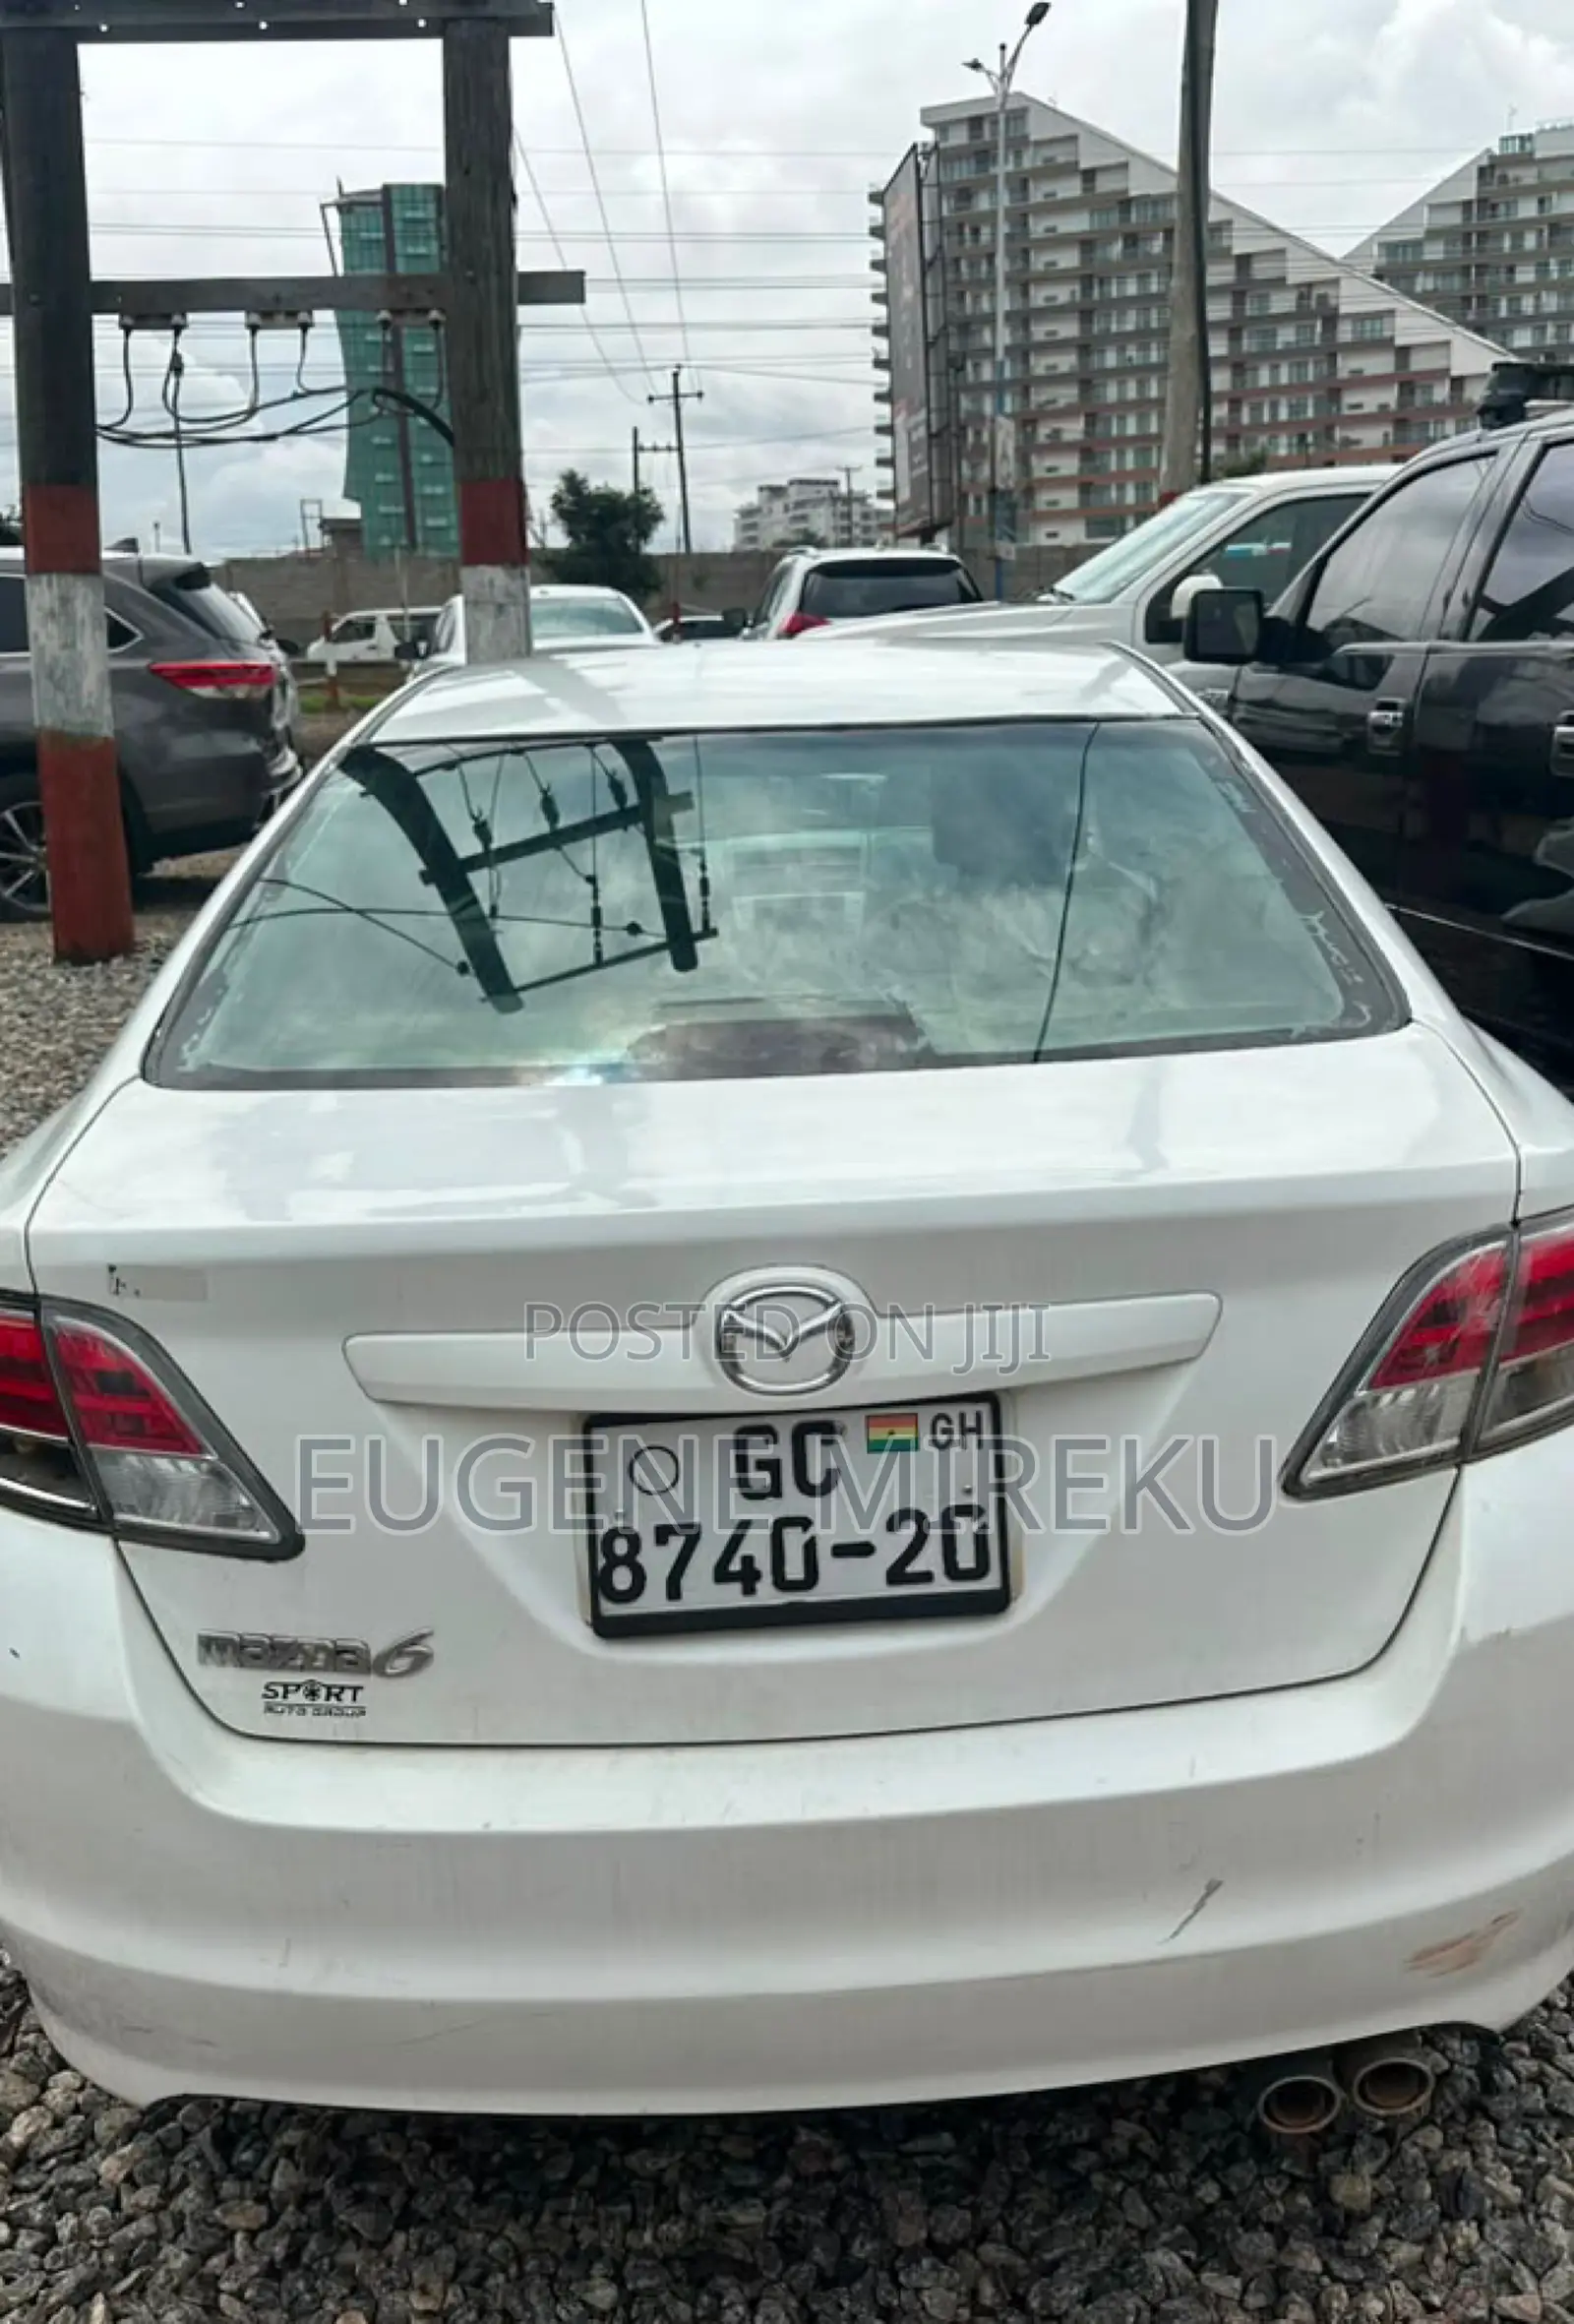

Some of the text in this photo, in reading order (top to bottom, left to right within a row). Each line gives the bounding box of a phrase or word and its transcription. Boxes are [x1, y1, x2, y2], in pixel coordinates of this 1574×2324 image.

[734, 1420, 842, 1501] GC
[930, 1411, 985, 1450] GH
[597, 1503, 990, 1605] 8740-20
